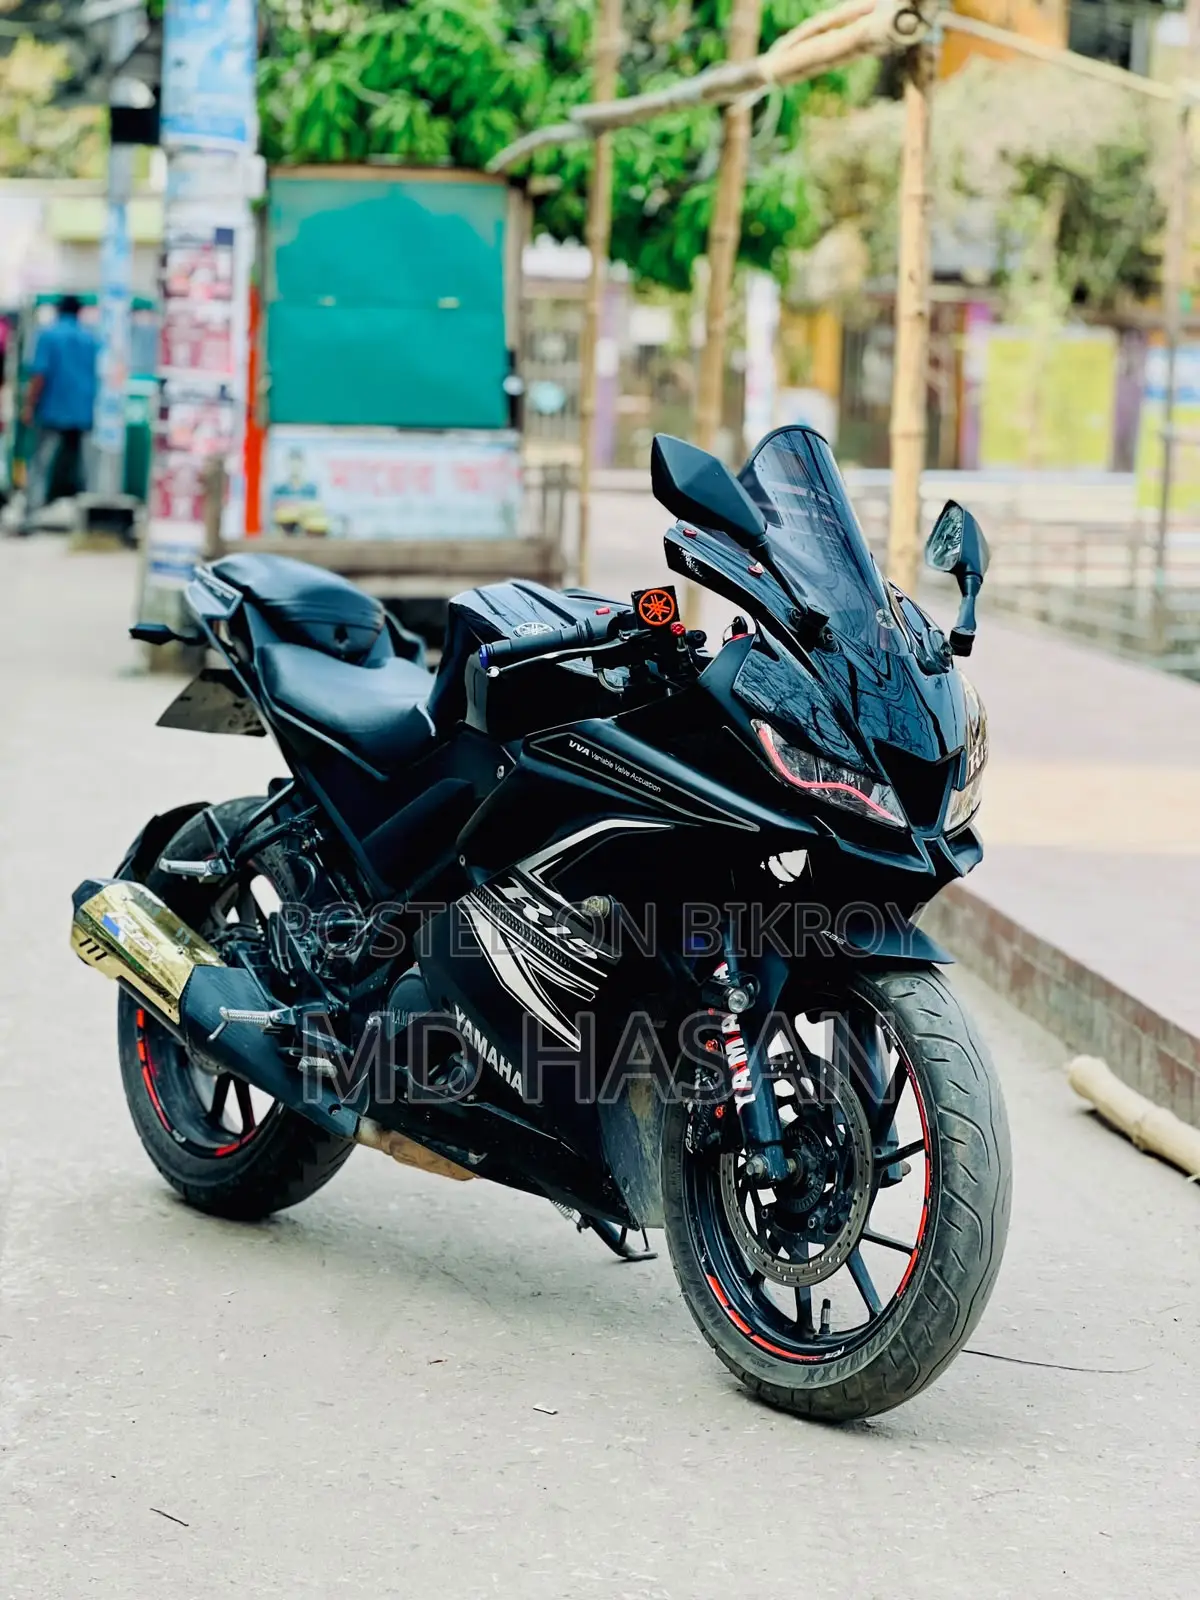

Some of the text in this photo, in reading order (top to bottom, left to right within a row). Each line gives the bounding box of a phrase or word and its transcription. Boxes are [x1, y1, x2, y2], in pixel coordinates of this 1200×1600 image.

[569, 740, 662, 793] VVA Variable Valve Actuation
[454, 1004, 524, 1097] YAMAHA
[713, 961, 756, 1115] YAMAA
